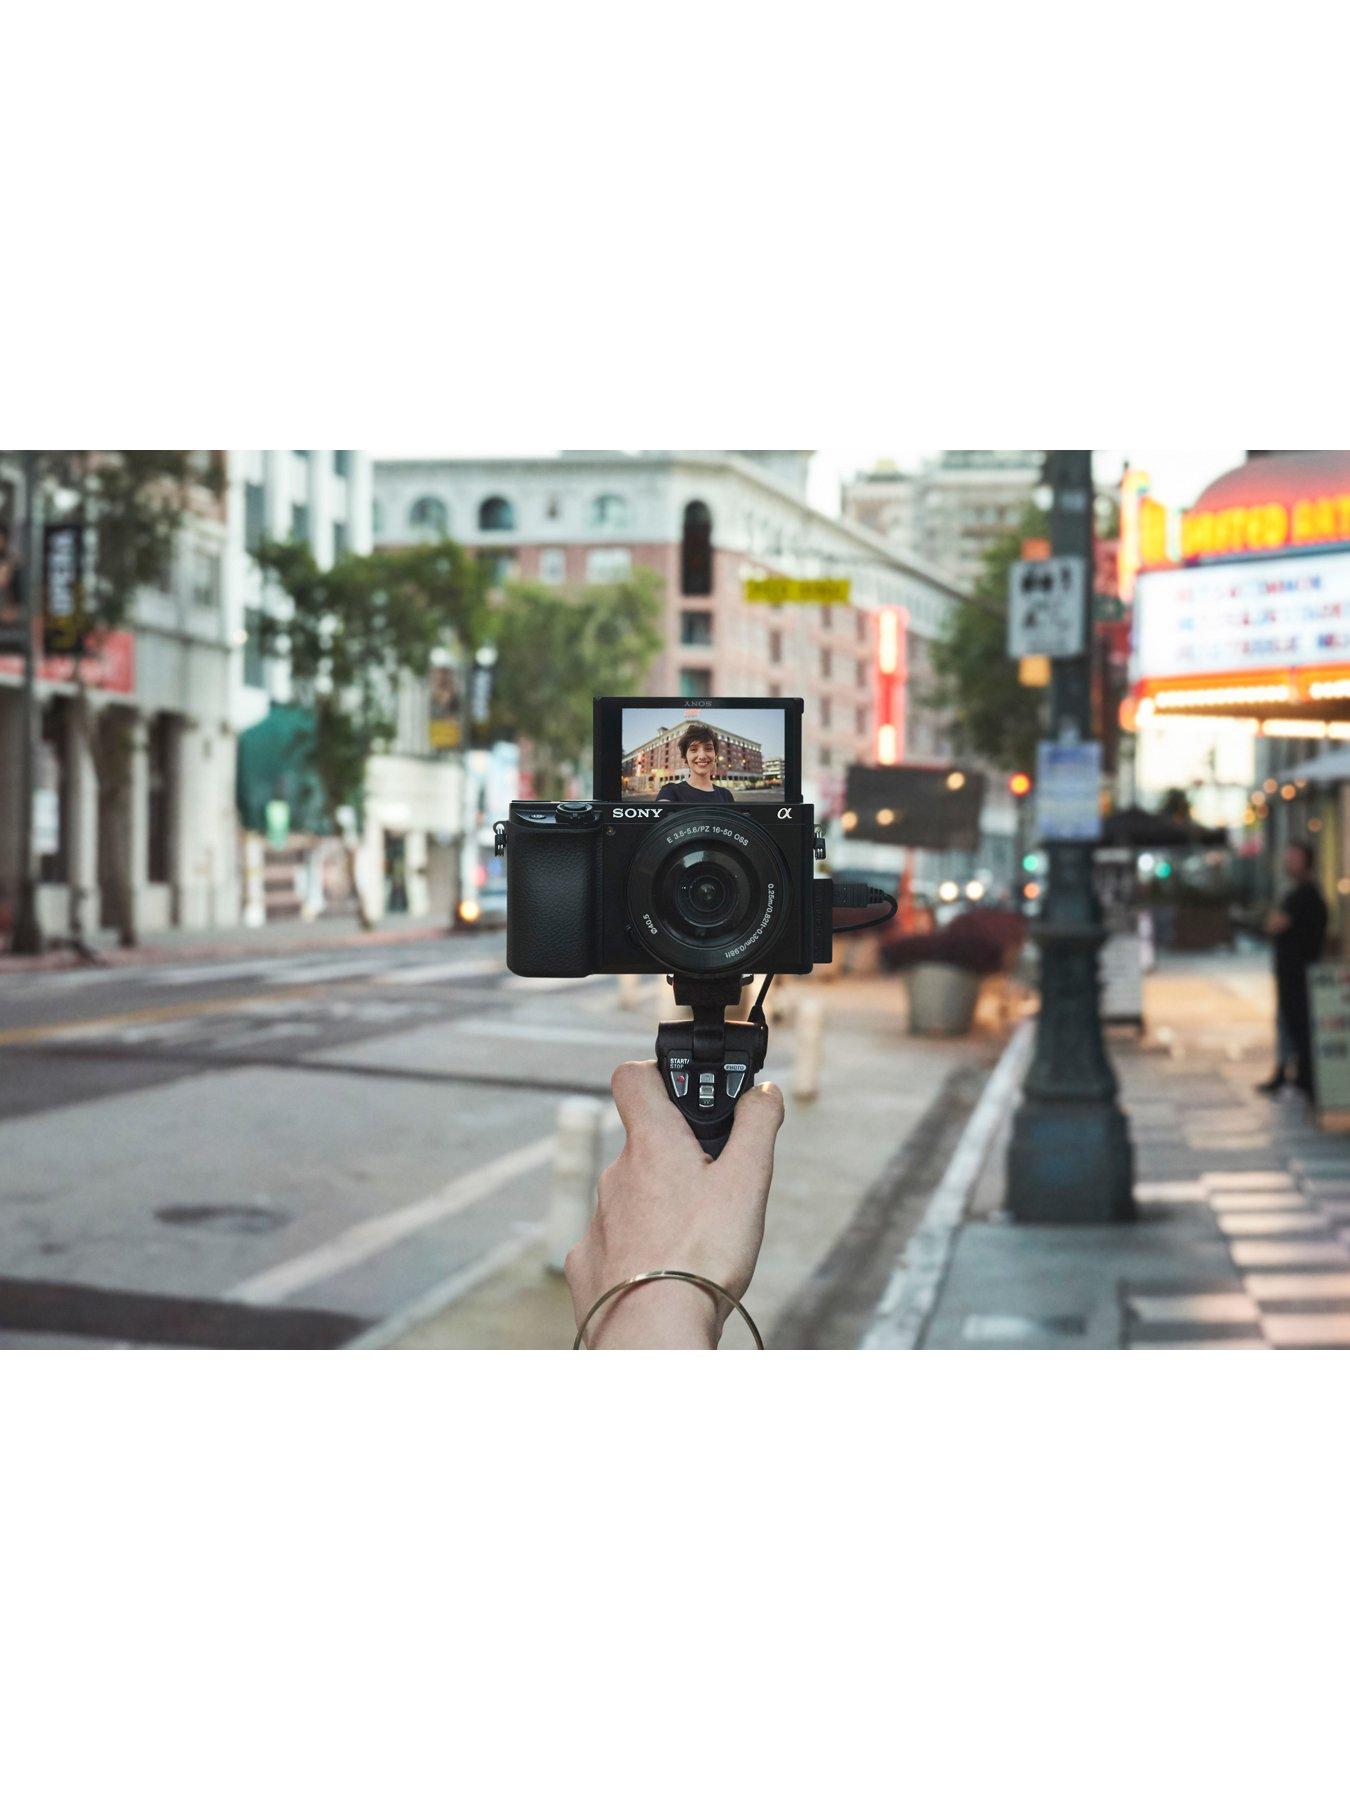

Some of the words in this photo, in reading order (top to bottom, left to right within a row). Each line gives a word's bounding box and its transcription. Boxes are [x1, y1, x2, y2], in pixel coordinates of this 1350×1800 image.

[612, 808, 663, 819] SONY
[712, 826, 733, 837] 16-50
[734, 833, 749, 846] OSS
